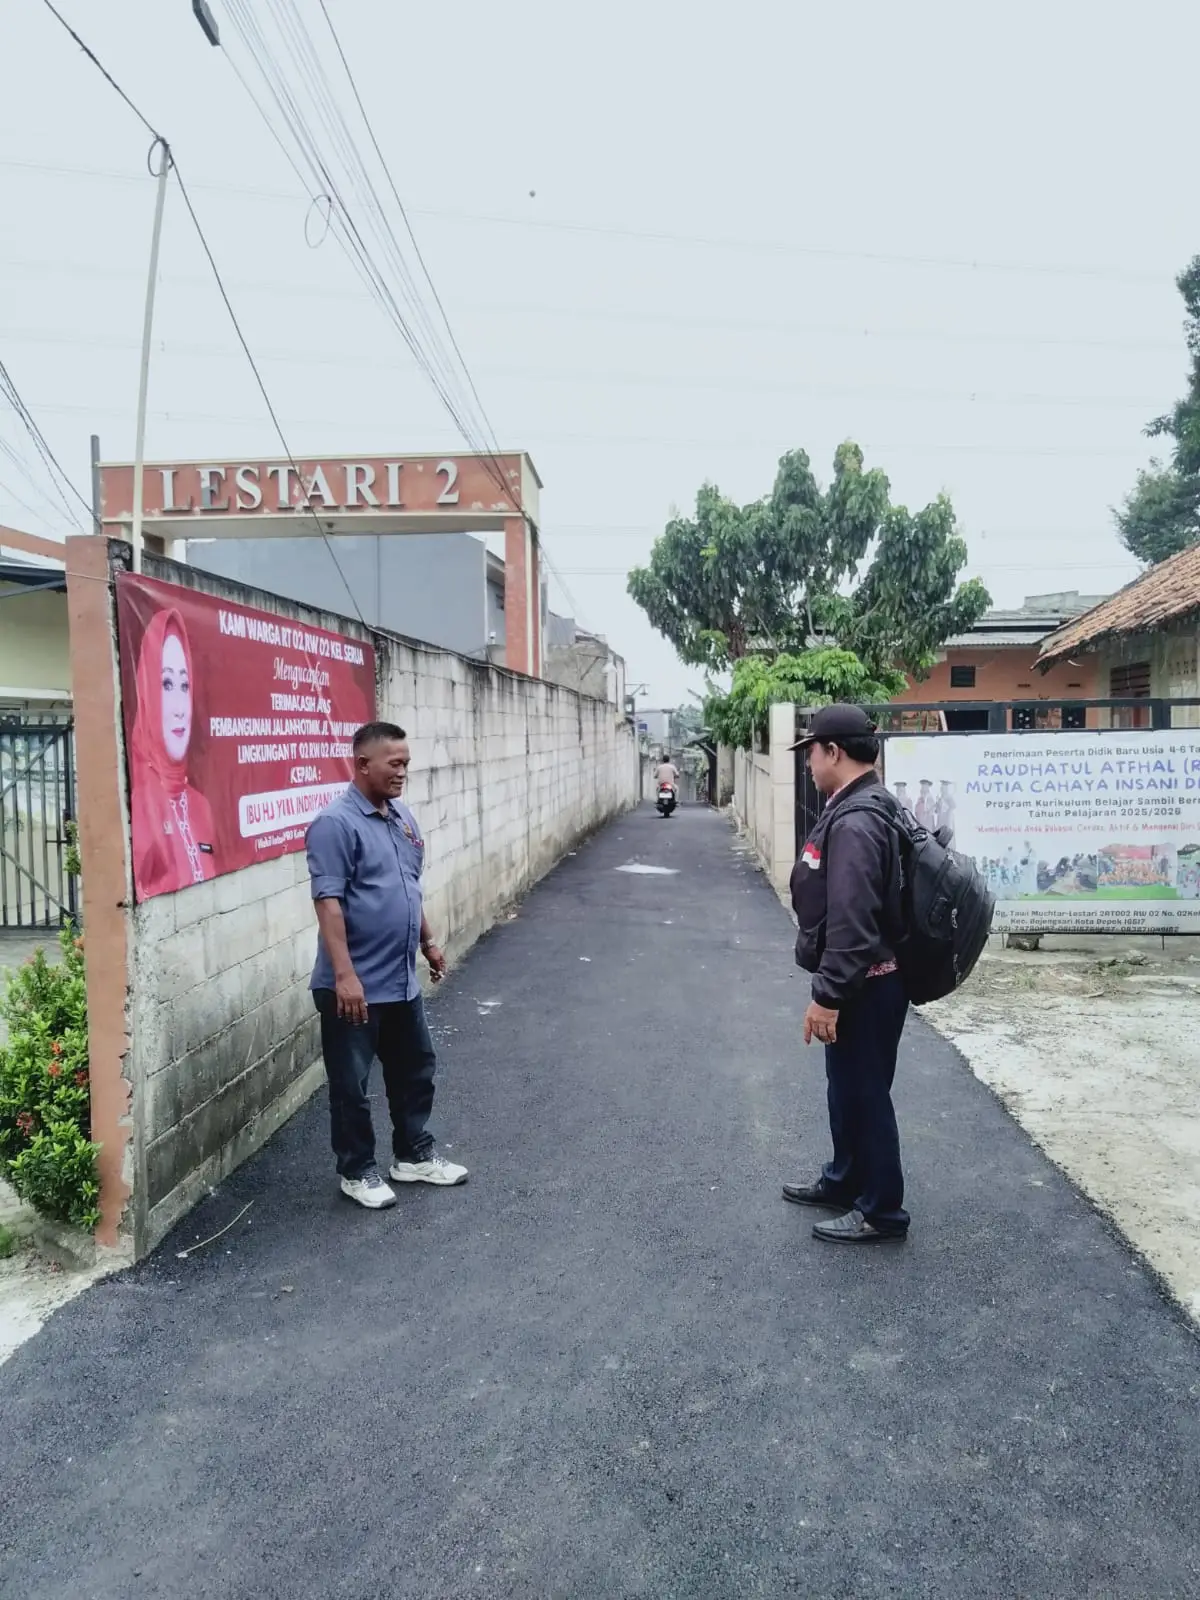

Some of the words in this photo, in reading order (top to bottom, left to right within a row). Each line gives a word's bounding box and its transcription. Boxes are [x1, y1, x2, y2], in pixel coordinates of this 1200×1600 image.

[159, 463, 404, 512] LESTARI
[436, 460, 461, 505] 2
[218, 609, 247, 638] KAMI
[246, 617, 282, 645] WARGA
[281, 627, 292, 649] RT
[304, 634, 318, 655] RW
[319, 638, 331, 658] 02
[273, 656, 330, 692] Mengucapkan
[209, 717, 272, 737] PEMBANGUNAN
[237, 743, 290, 764] LINGKUNGAN
[320, 742, 330, 758] 02
[983, 749, 1043, 758] Penerimaan
[1046, 748, 1085, 757] Peserta
[1088, 746, 1112, 756] Didik
[1116, 747, 1140, 755] Baru
[1142, 745, 1164, 754] Usia
[1169, 745, 1186, 754] 4-6
[978, 760, 1092, 777] RAUDHATUL
[1100, 759, 1175, 774] ATFHAL
[966, 780, 1023, 794] MUTIA
[1030, 779, 1108, 793] CAHAYA
[1116, 777, 1178, 790] INSANI
[986, 800, 1032, 810] Program
[1036, 798, 1091, 807] Kurikulum
[1095, 797, 1133, 807] Belajar
[1137, 796, 1174, 805] Sambil
[1028, 810, 1061, 818] Tahun
[1064, 809, 1117, 819] Pelajaran
[1121, 807, 1181, 816] 2025/2026
[246, 804, 261, 825] IBU
